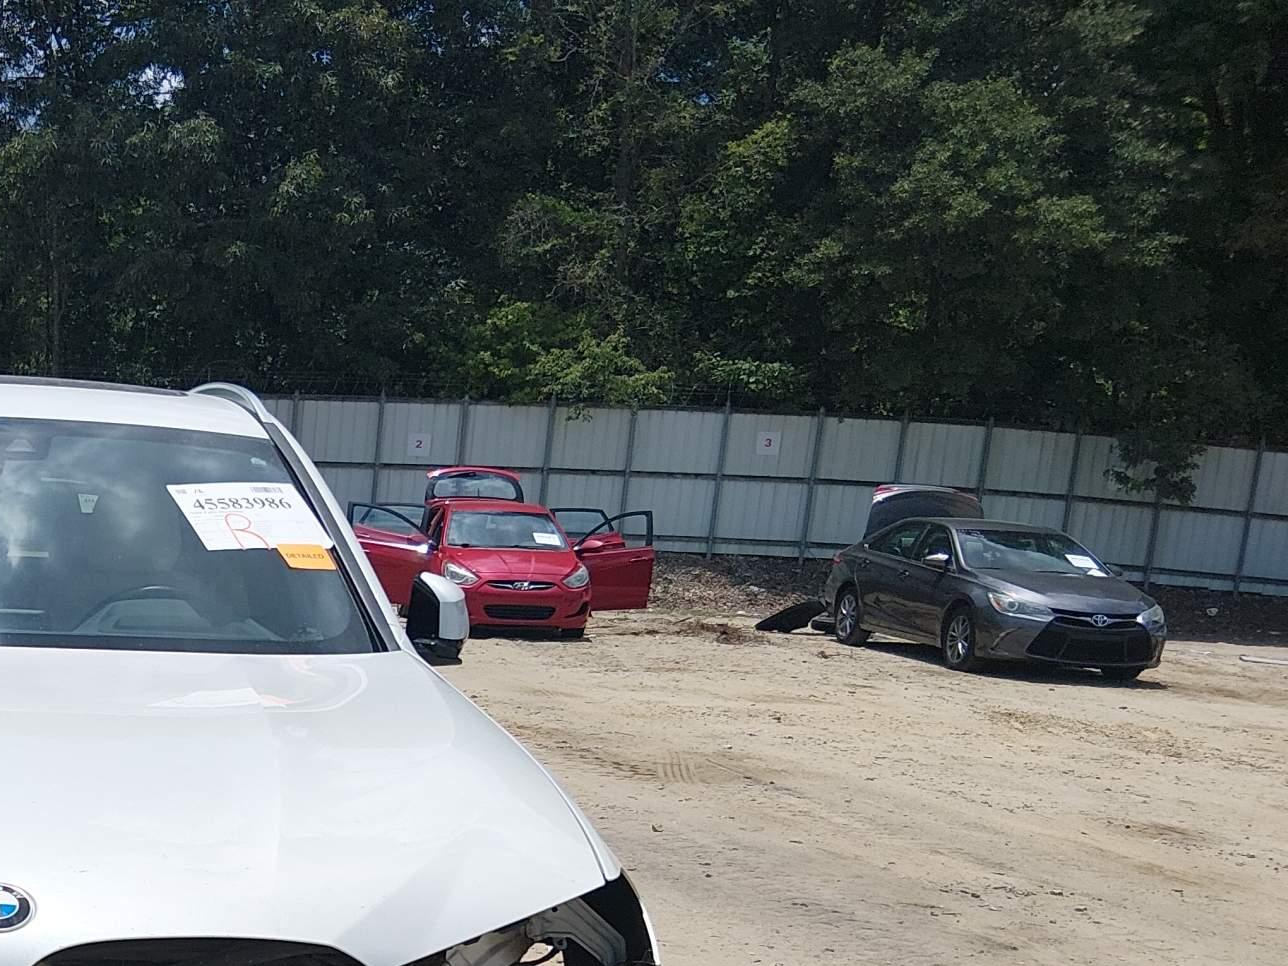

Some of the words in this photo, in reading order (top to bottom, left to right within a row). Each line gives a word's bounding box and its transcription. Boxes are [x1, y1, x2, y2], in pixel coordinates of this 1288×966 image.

[415, 440, 423, 449] 2
[764, 438, 772, 448] 3
[193, 497, 292, 510] 45583986
